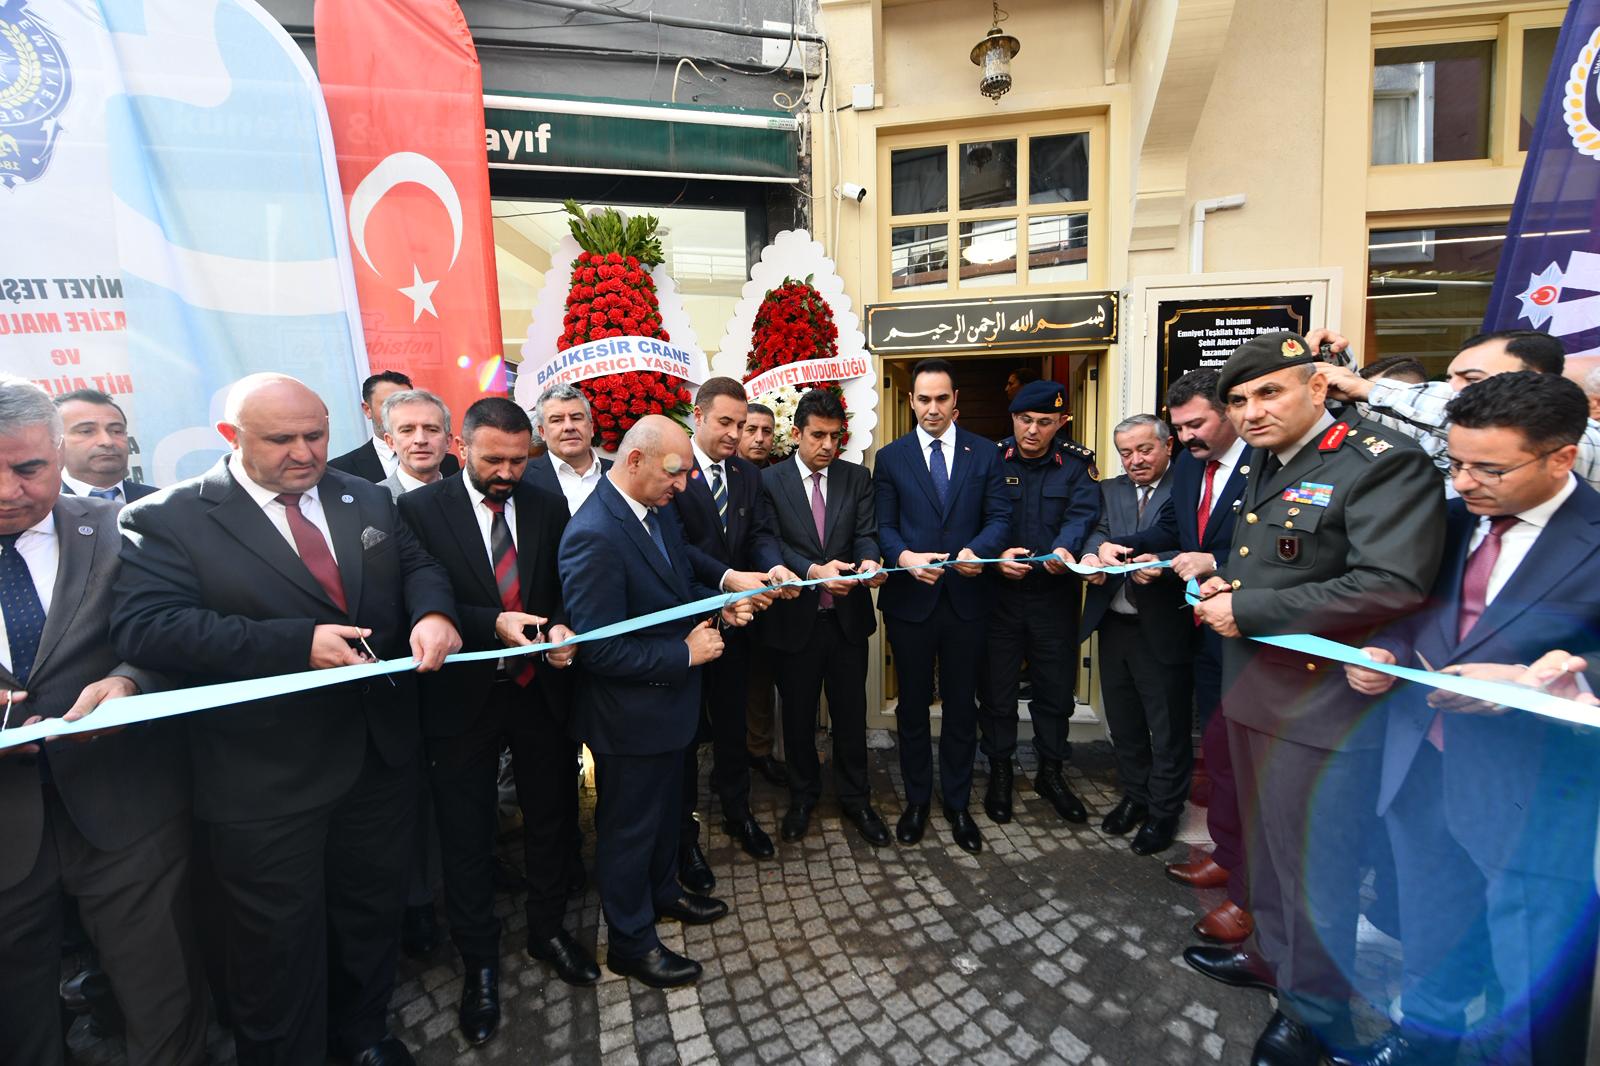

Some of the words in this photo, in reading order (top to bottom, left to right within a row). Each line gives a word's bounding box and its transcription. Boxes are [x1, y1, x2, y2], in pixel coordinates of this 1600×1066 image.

[1215, 318, 1225, 326] Bu
[1177, 329, 1204, 338] Emniyet
[1234, 326, 1255, 336] Vazife
[1198, 339, 1216, 348] Şehit
[536, 340, 632, 386] BALIKESİR
[637, 340, 691, 366] CRANE
[641, 355, 690, 378] YASAR
[751, 367, 799, 397] EMNİYET
[801, 356, 867, 381] MÜDÜRLÜĞÜ
